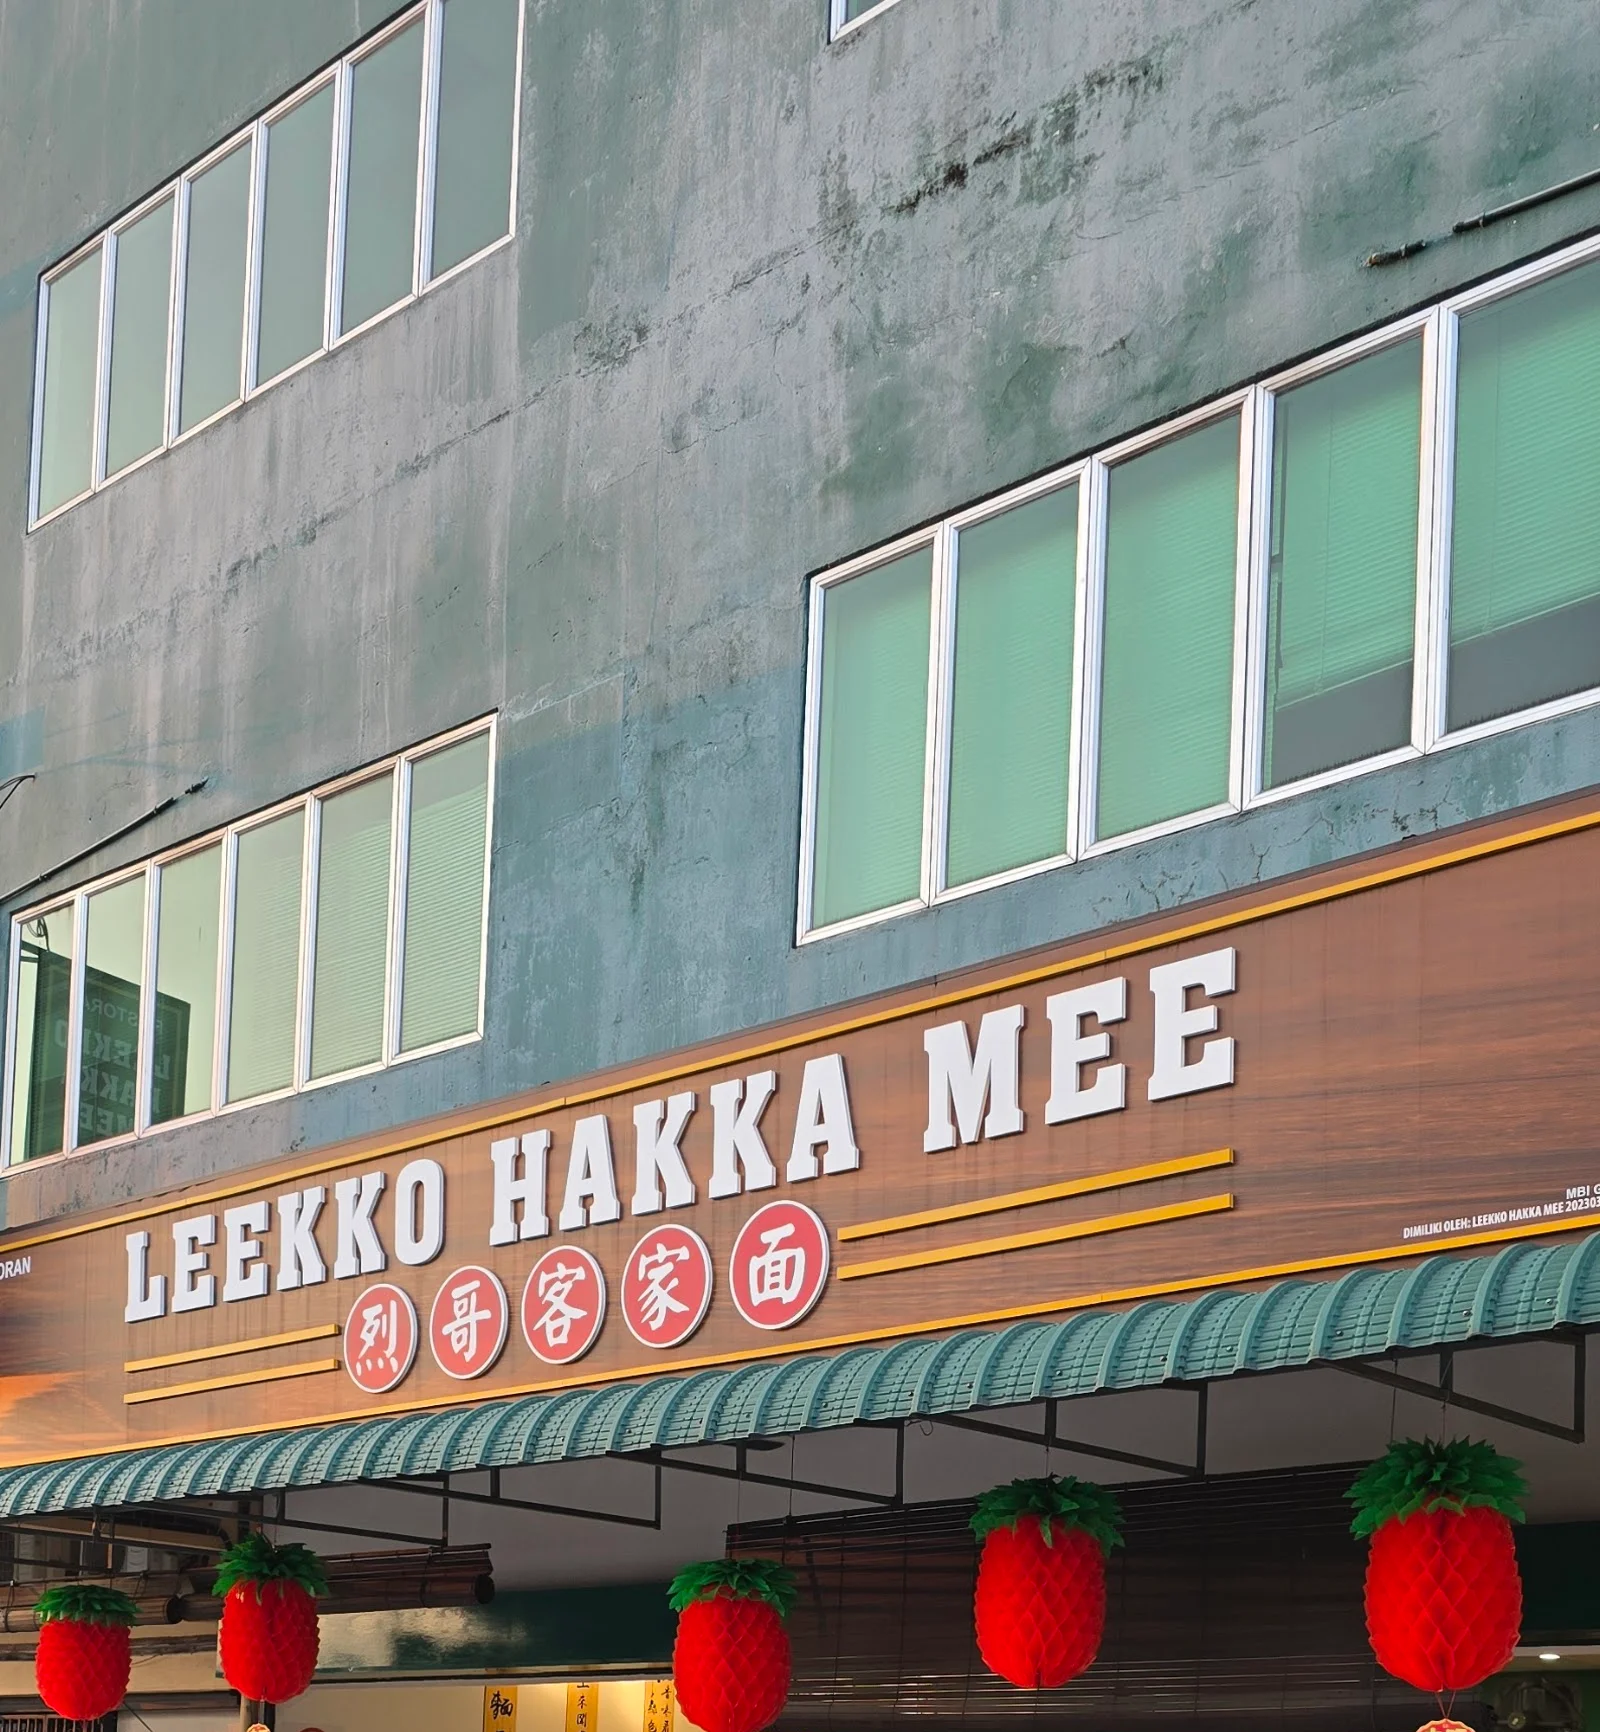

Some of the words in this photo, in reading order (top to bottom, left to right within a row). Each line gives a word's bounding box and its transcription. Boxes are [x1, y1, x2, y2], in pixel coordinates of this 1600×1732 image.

[125, 1158, 445, 1323] LEEKKO
[489, 1053, 861, 1247] HAKKA
[923, 947, 1237, 1154] MEE
[1403, 1222, 1442, 1239] DIMILIKI
[1444, 1219, 1471, 1232] OLEH:
[1472, 1211, 1508, 1228] LEEKKO
[1509, 1205, 1541, 1222] HAKKA
[1544, 1201, 1565, 1216] MEE
[1566, 1185, 1590, 1200] MBI
[355, 1223, 806, 1374] 烈哥客家面
